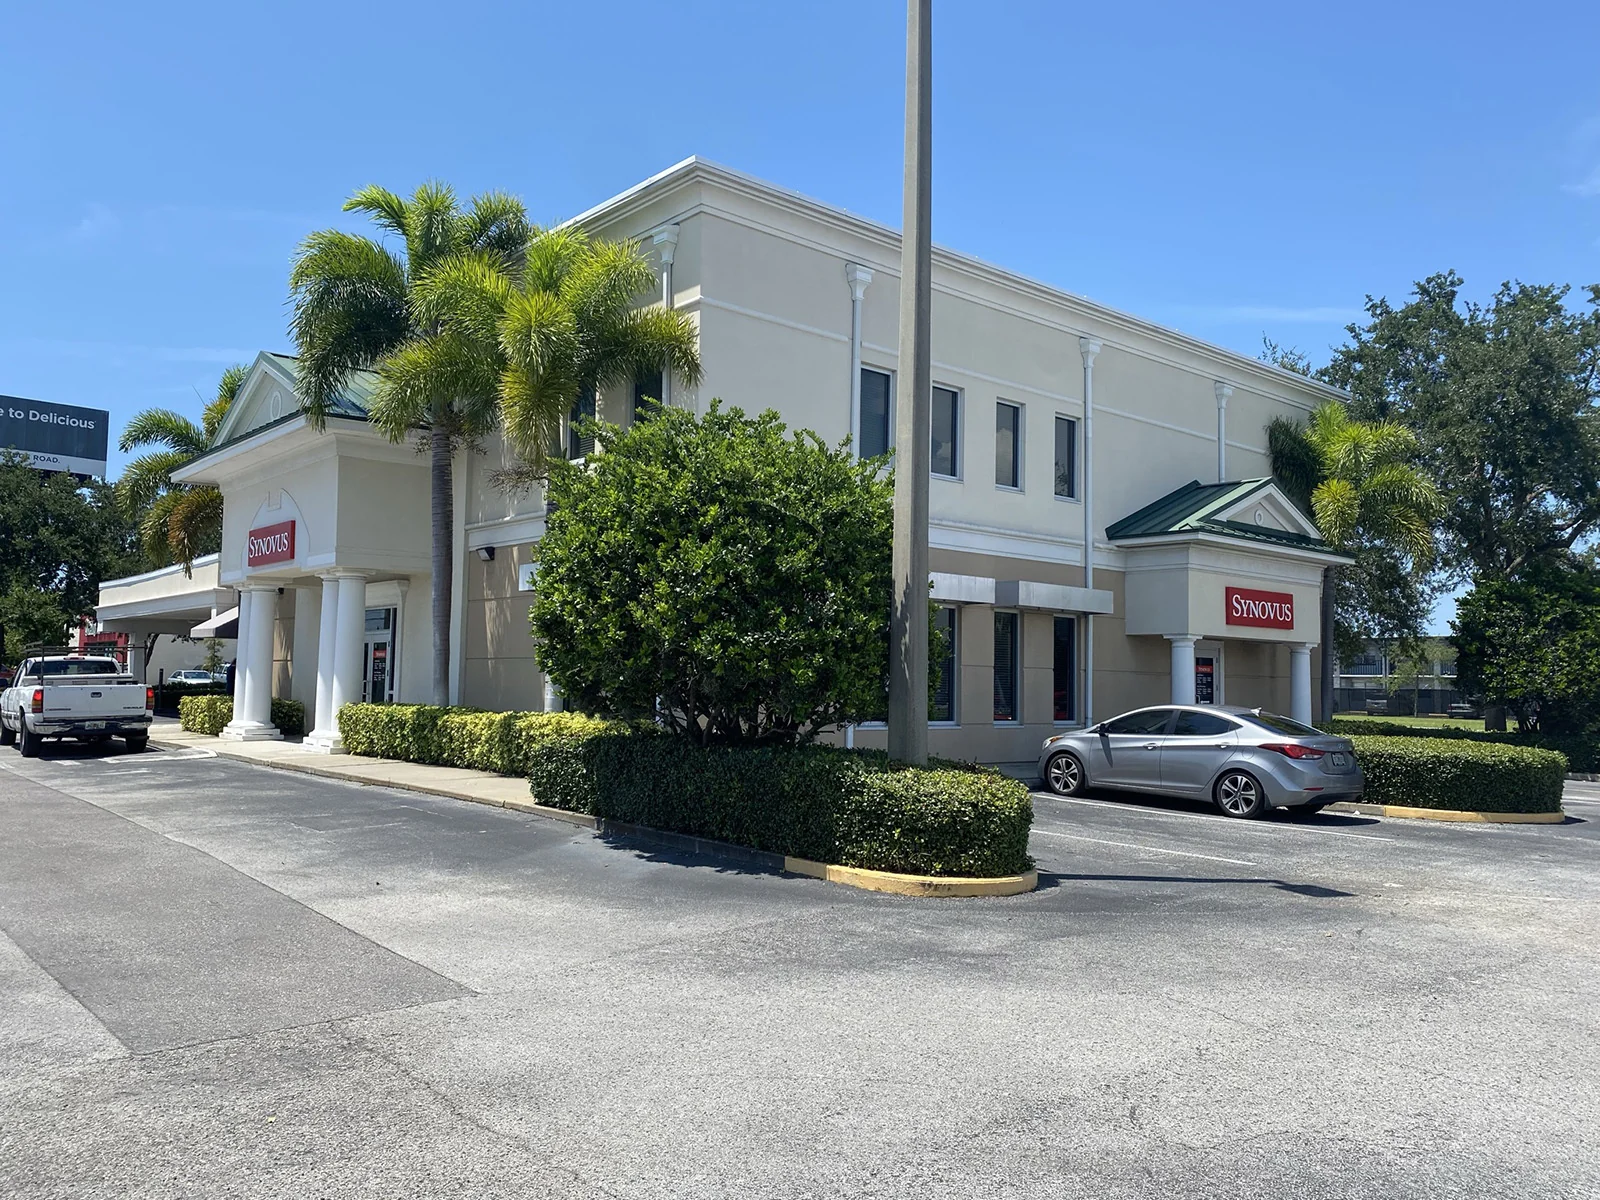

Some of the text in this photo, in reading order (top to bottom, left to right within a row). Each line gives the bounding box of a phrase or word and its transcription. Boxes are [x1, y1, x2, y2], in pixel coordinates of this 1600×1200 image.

[8, 407, 24, 419] to
[29, 410, 95, 429] Delicious
[33, 454, 60, 464] ROAD.
[249, 532, 288, 558] SYNOVUS
[1232, 594, 1292, 621] SYNOVUS
